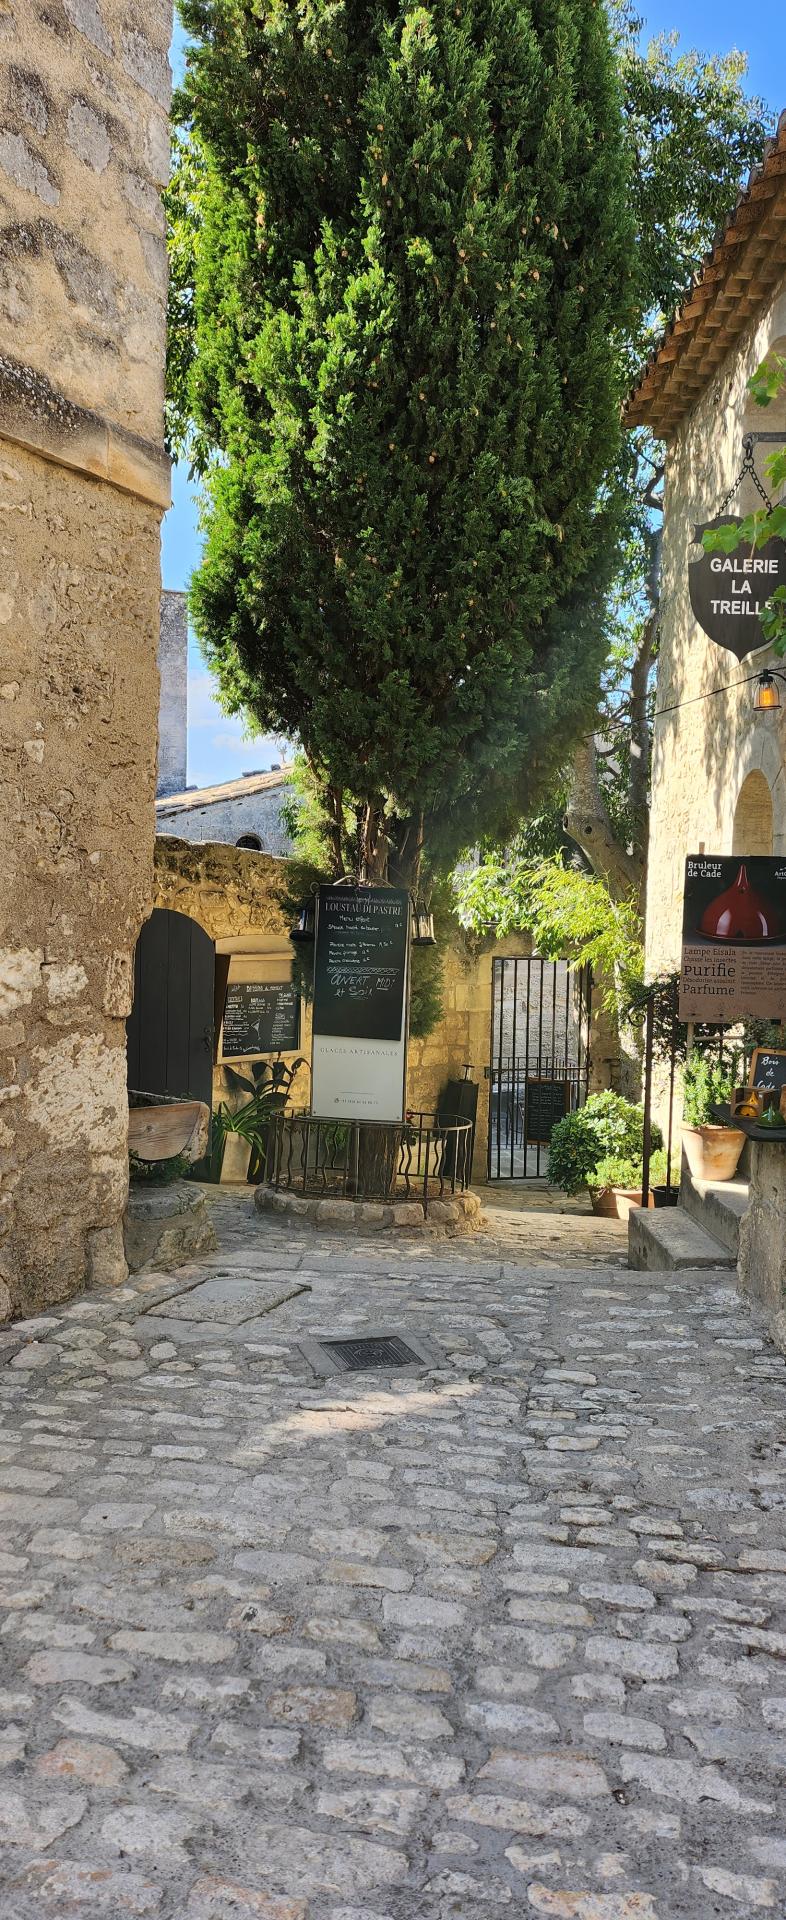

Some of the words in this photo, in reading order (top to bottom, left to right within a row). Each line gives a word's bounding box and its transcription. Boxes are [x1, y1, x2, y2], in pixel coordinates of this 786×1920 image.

[710, 558, 779, 574] GALERIE
[731, 580, 752, 594] LA
[688, 861, 722, 870] Bruleur
[687, 869, 698, 877] de
[700, 870, 722, 878] Cade
[325, 902, 361, 913] LOUSTAU
[684, 947, 711, 957] Lampe
[683, 962, 736, 977] Purifie
[682, 983, 735, 996] Parfume
[760, 1056, 779, 1066] Bois
[765, 1067, 775, 1077] de
